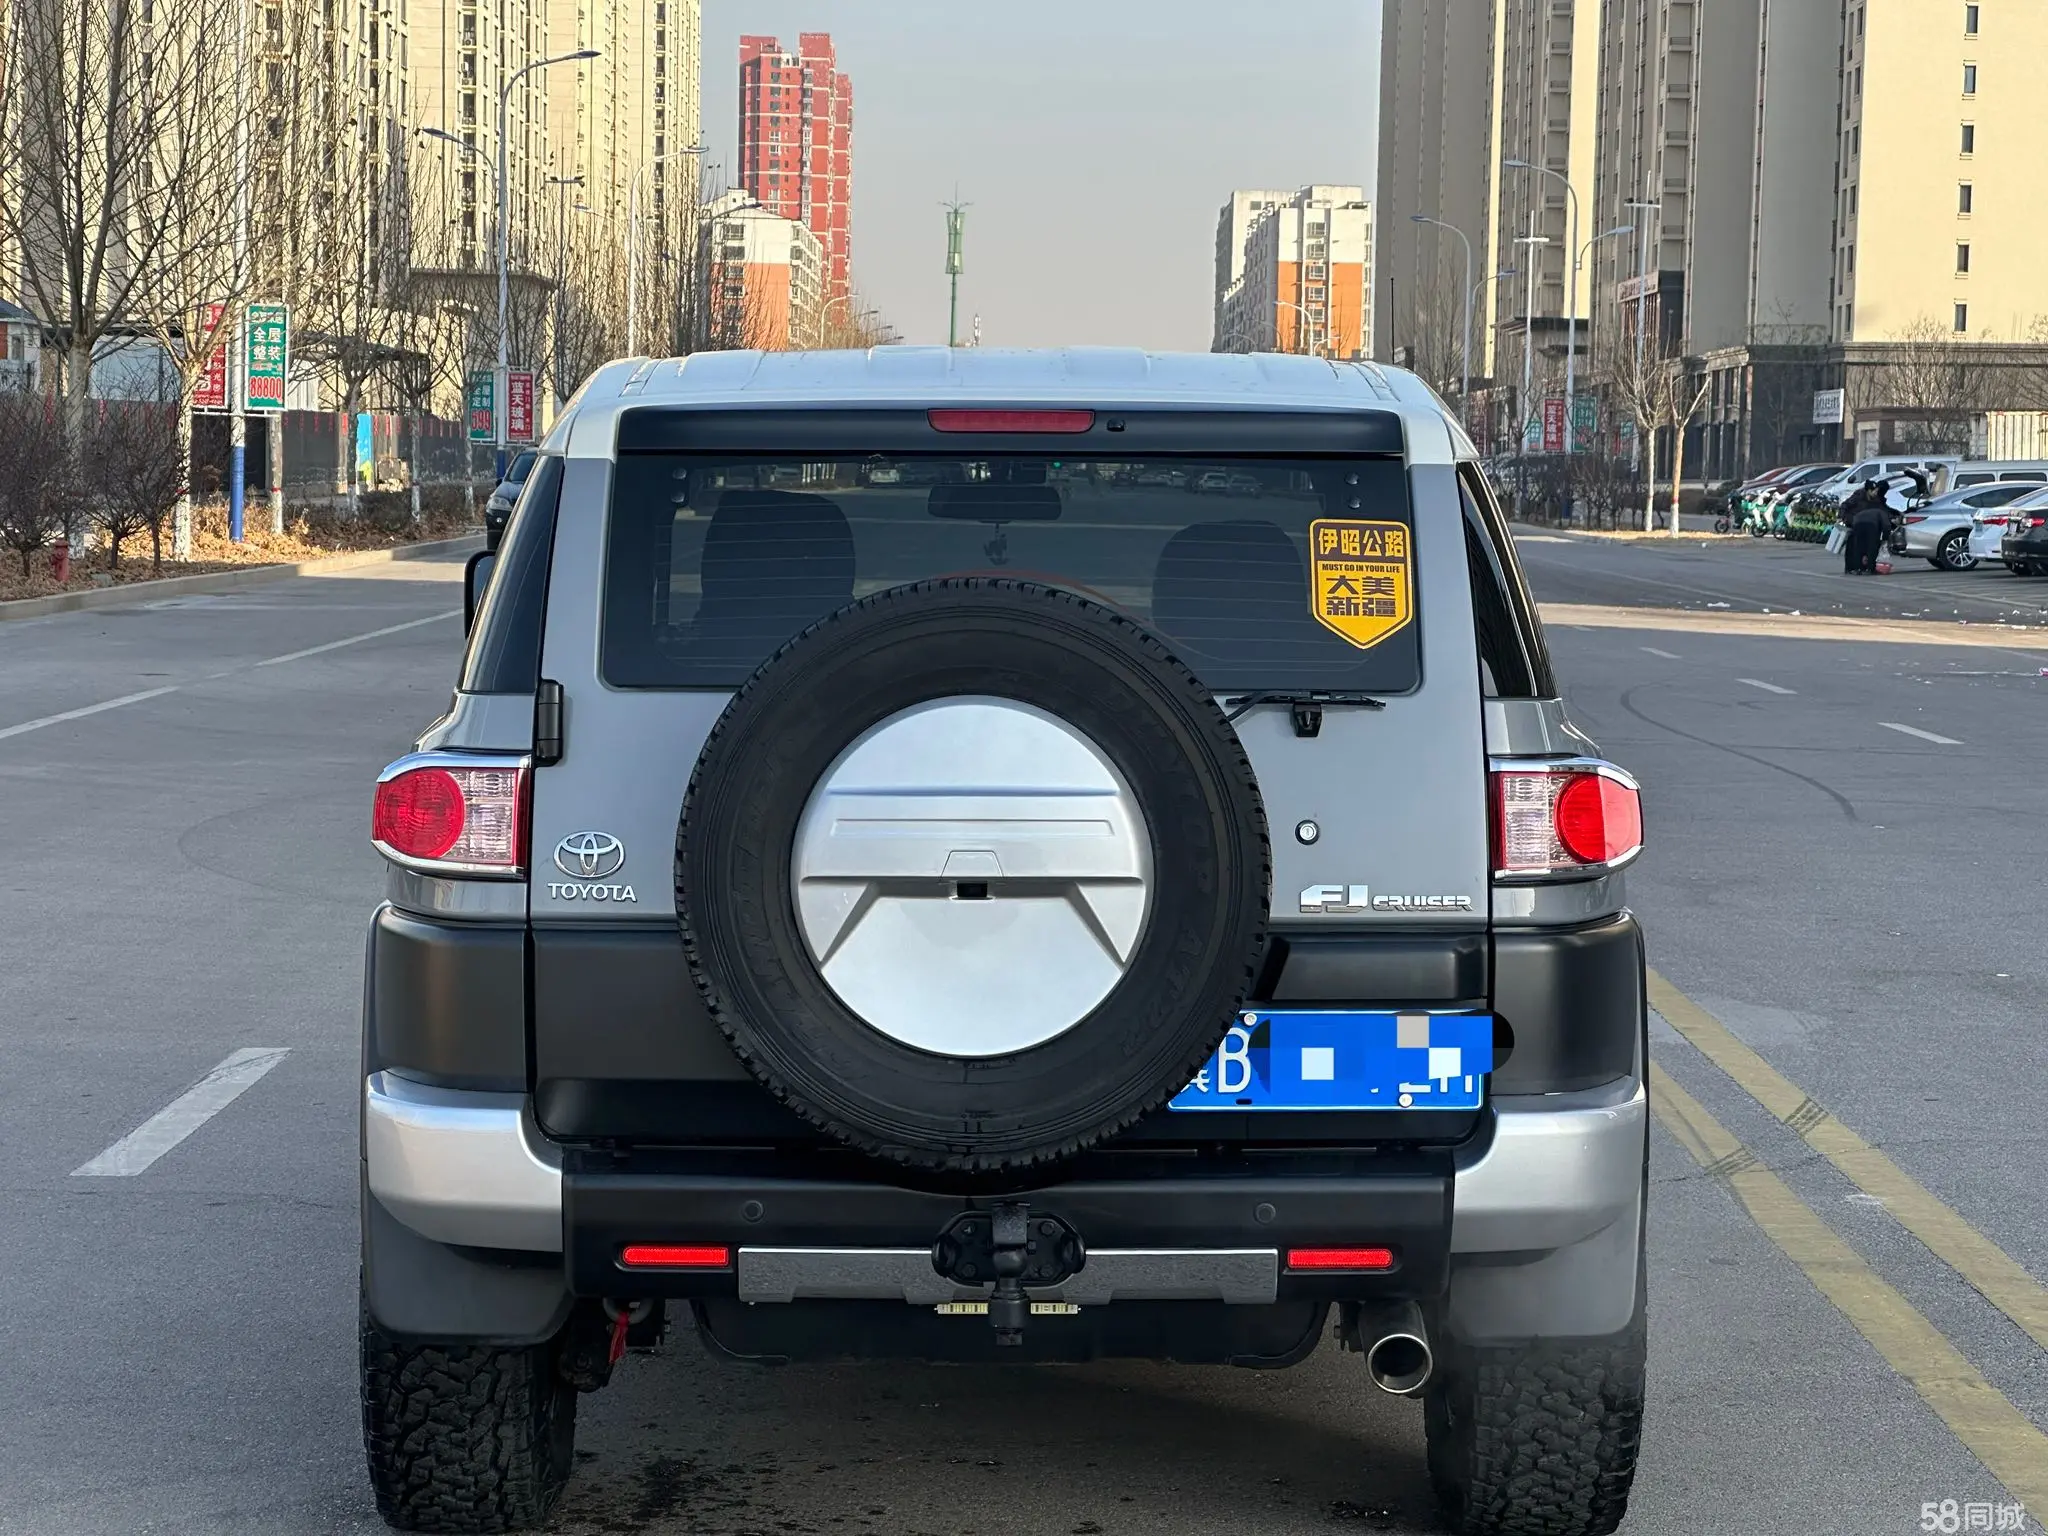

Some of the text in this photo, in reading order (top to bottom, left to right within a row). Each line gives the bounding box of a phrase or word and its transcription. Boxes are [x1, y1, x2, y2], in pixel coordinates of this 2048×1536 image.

[253, 326, 281, 342] 全屋
[253, 344, 281, 360] 整装
[510, 381, 525, 431] 蓝天玻璃
[471, 409, 491, 432] 599
[1319, 528, 1404, 557] 伊昭公路
[1322, 563, 1400, 573] MUST GO IN YOUR LIFE
[1326, 575, 1395, 596] 大美
[1326, 596, 1396, 617] 新疆
[547, 882, 637, 902] TOYOTA
[1300, 884, 1473, 913] FJ CRUISER
